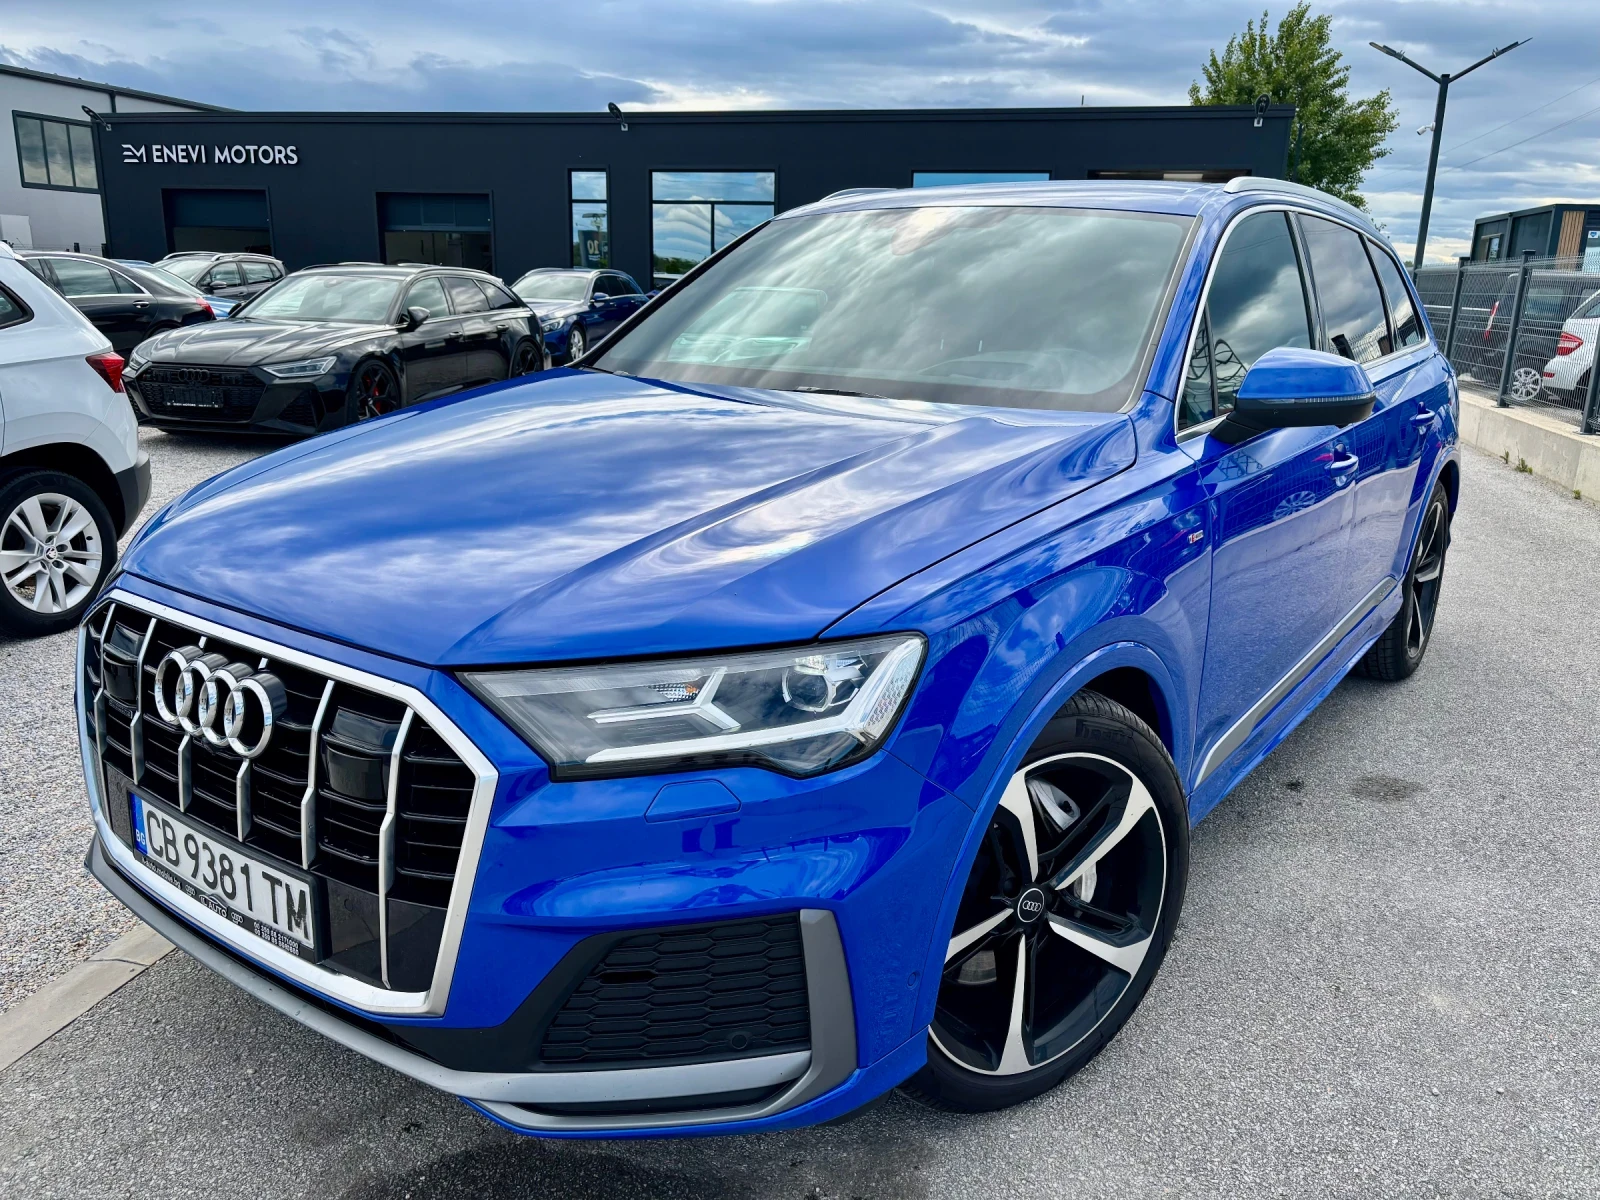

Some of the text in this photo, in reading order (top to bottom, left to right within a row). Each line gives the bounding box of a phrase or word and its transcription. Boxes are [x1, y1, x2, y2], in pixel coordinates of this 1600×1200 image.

[152, 145, 206, 164] ENEVI
[214, 145, 298, 165] MOTORS
[135, 829, 146, 846] BG
[146, 810, 310, 941] CB 9381 TM
[208, 902, 227, 918] AUTO
